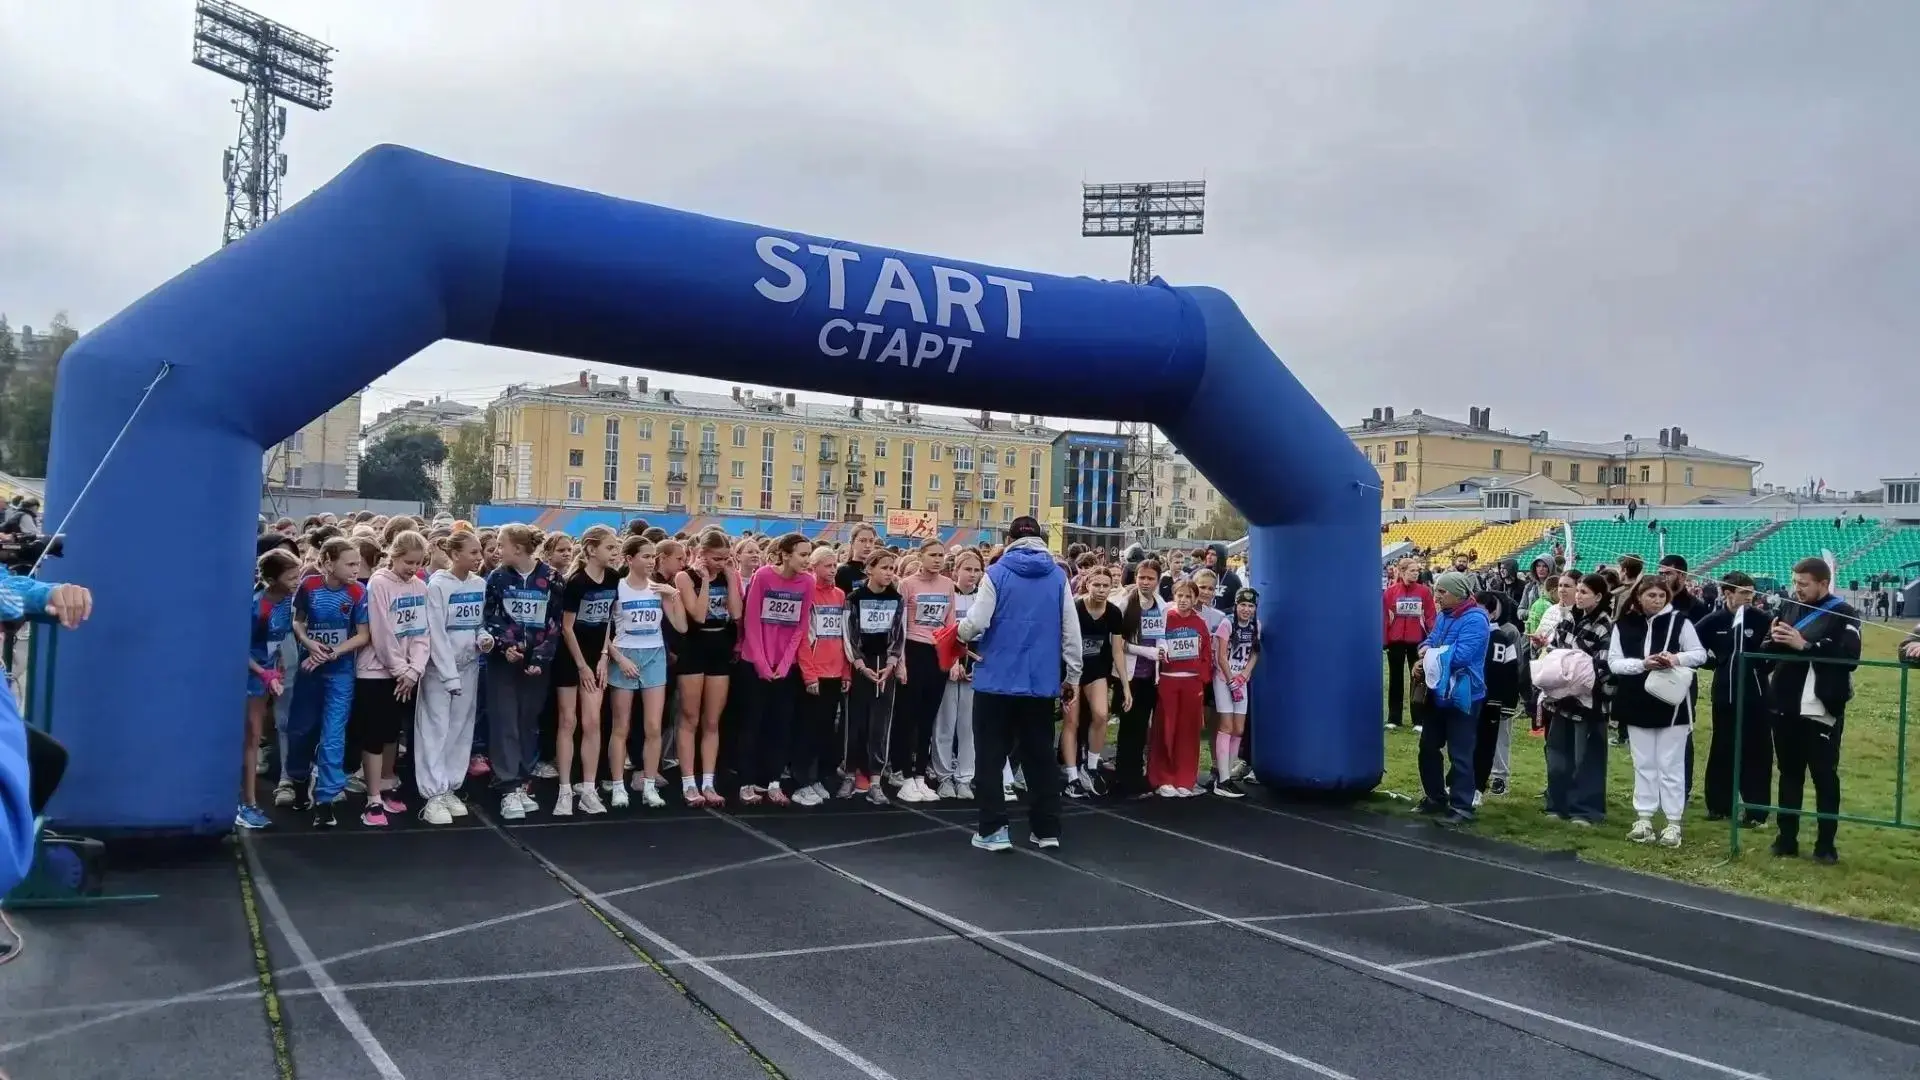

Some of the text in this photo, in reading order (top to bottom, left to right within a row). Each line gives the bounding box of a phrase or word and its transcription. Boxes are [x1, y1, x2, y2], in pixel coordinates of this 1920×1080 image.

[753, 236, 1033, 339] START
[818, 318, 973, 374] СТАРТ
[456, 604, 480, 618] 2616
[511, 601, 538, 614] 2831
[769, 601, 795, 614] 2824
[923, 604, 945, 615] 2671
[631, 610, 657, 623] 2780
[867, 611, 890, 622] 2601
[1173, 640, 1194, 651] 2664
[1493, 642, 1506, 663] B
